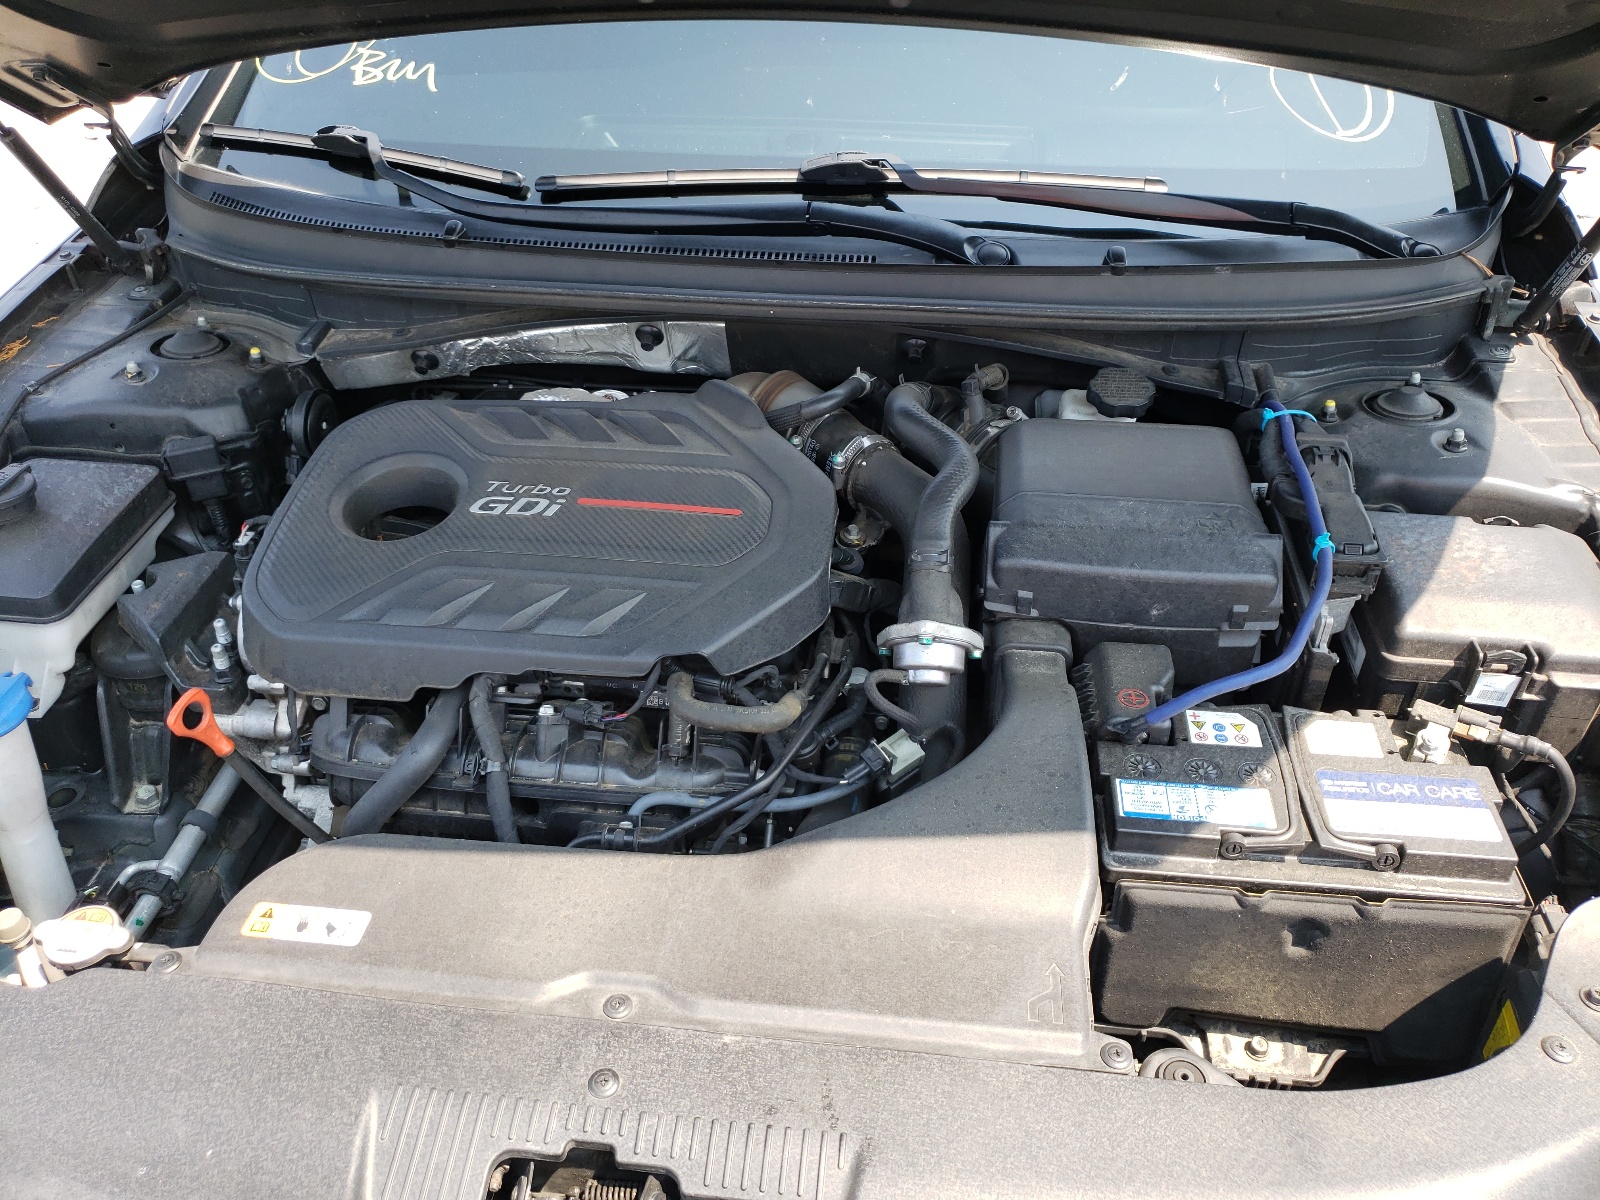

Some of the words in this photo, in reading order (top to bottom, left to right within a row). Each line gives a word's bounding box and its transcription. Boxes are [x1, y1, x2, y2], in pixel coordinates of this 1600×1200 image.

[486, 481, 572, 496] Turbo
[469, 496, 567, 517] GDi
[1376, 782, 1420, 797] CAR
[1424, 786, 1483, 801] CARE
